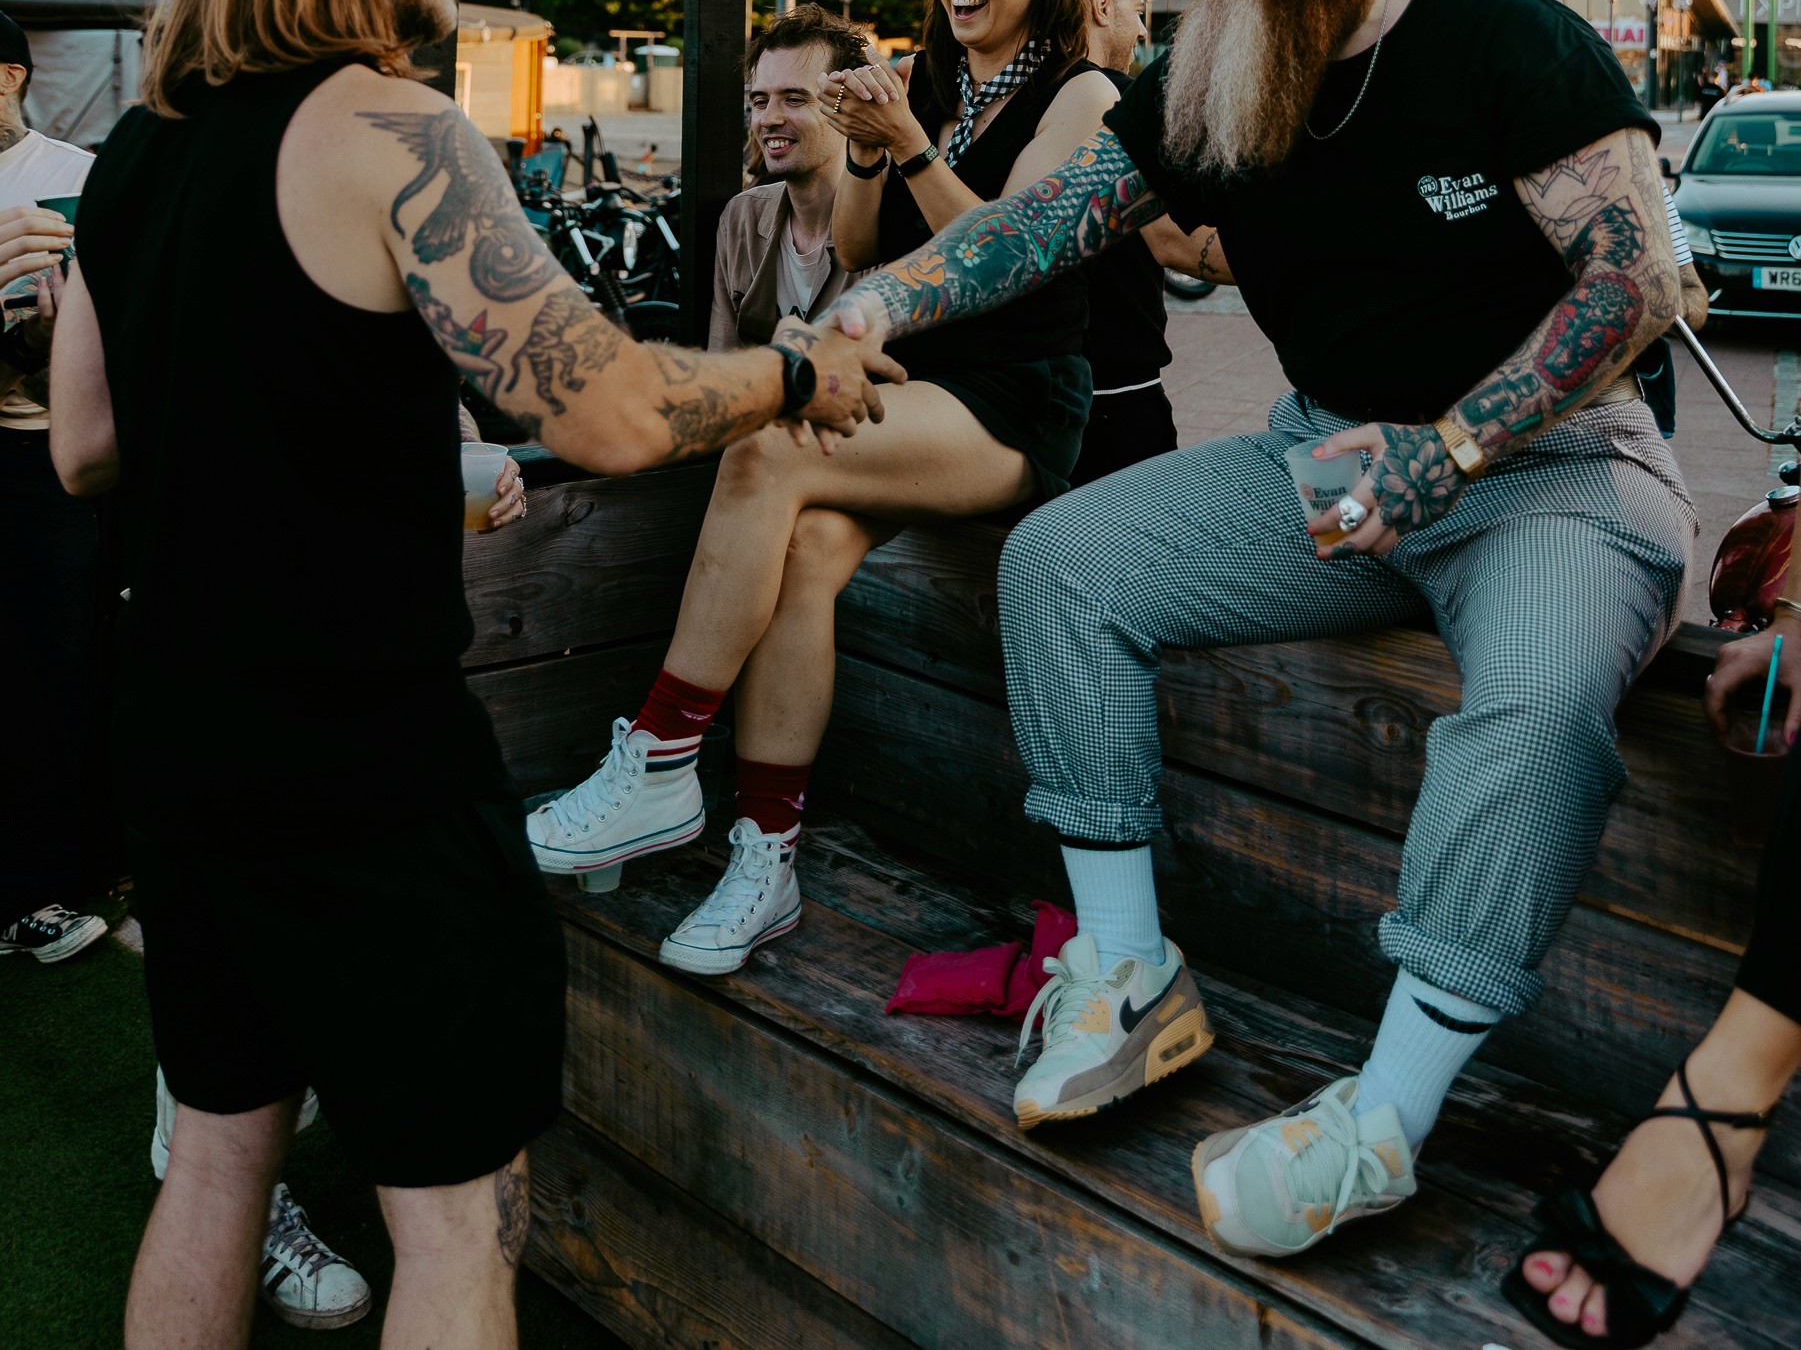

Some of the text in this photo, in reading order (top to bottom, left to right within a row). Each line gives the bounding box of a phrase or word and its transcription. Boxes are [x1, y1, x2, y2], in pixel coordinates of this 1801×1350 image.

[1439, 172, 1484, 194] Evan
[1425, 185, 1498, 213] Williams
[1445, 203, 1487, 221] Bourbon
[1768, 270, 1801, 286] WR6
[1312, 486, 1347, 498] Evan
